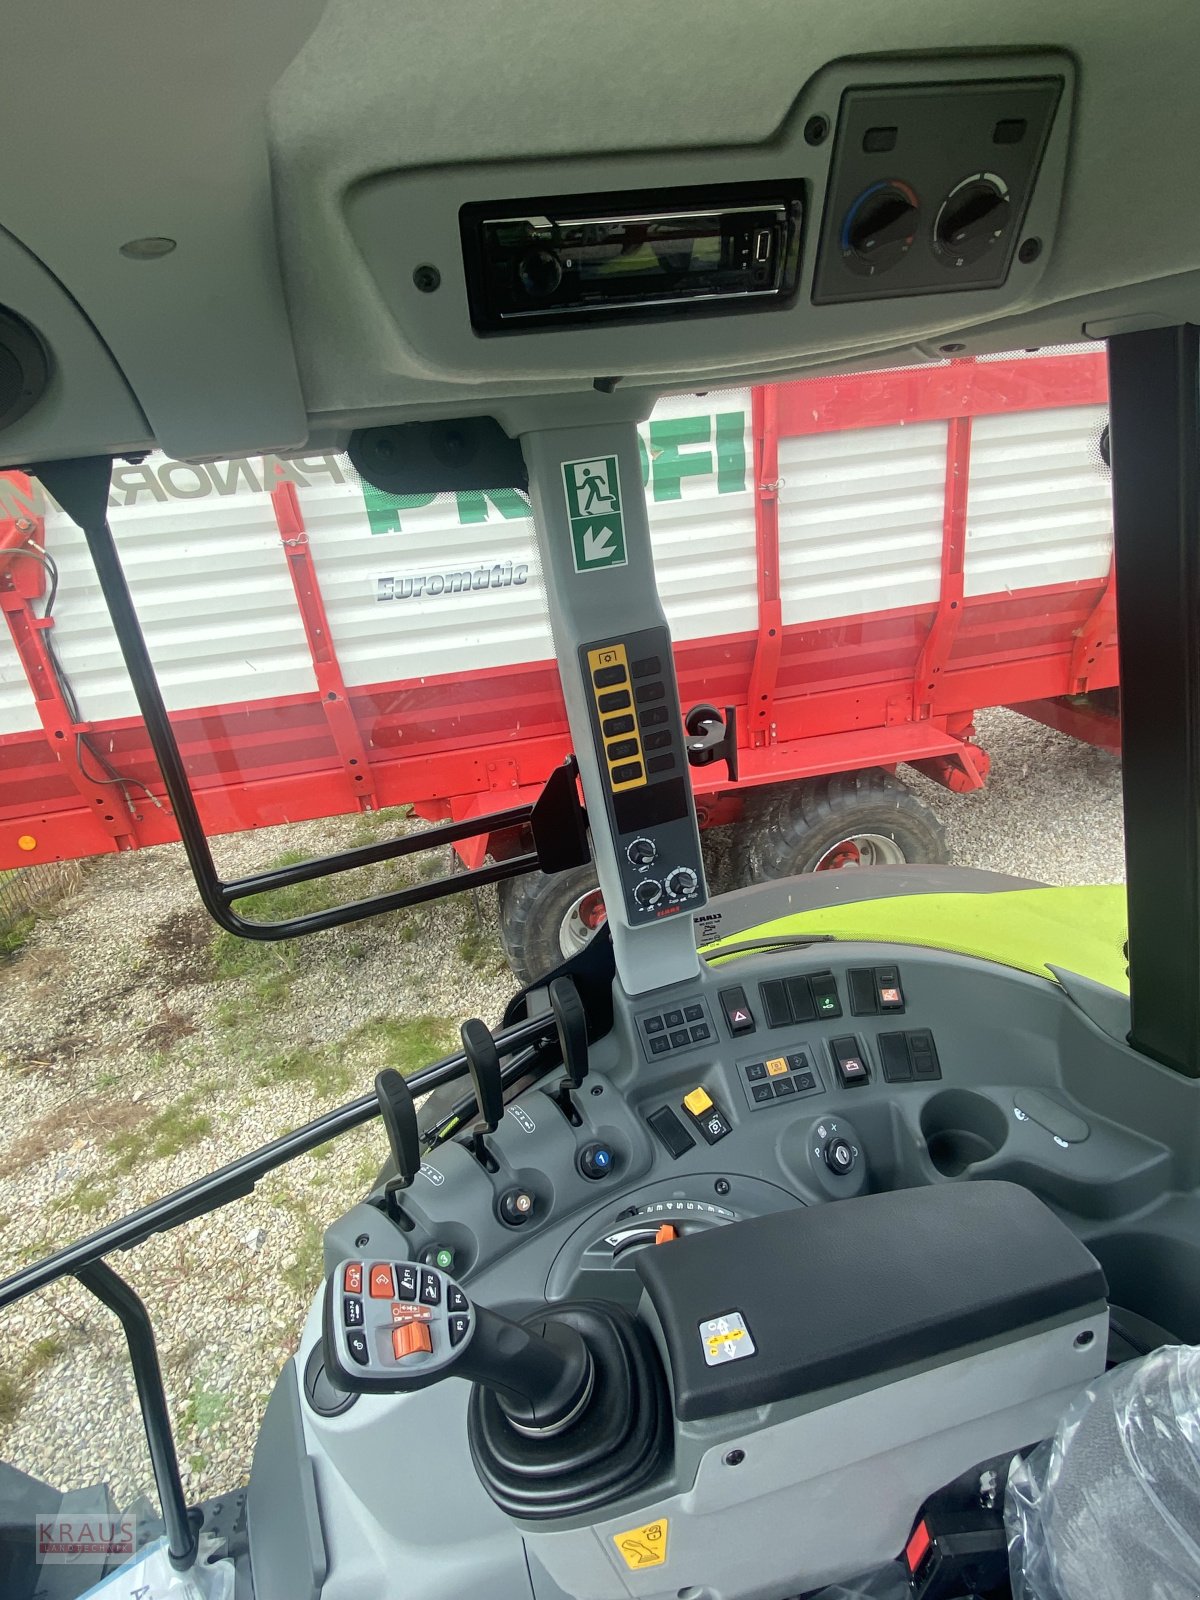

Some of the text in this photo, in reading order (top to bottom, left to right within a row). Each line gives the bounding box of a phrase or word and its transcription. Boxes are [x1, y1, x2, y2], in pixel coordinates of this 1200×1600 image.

[376, 559, 529, 601] Euromatic
[598, 1153, 605, 1163] 1
[519, 1199, 528, 1209] 2
[440, 1254, 448, 1264] 3
[404, 1269, 410, 1277] F1
[427, 1275, 434, 1285] F2
[455, 1294, 462, 1304] F4
[456, 1320, 464, 1331] F3
